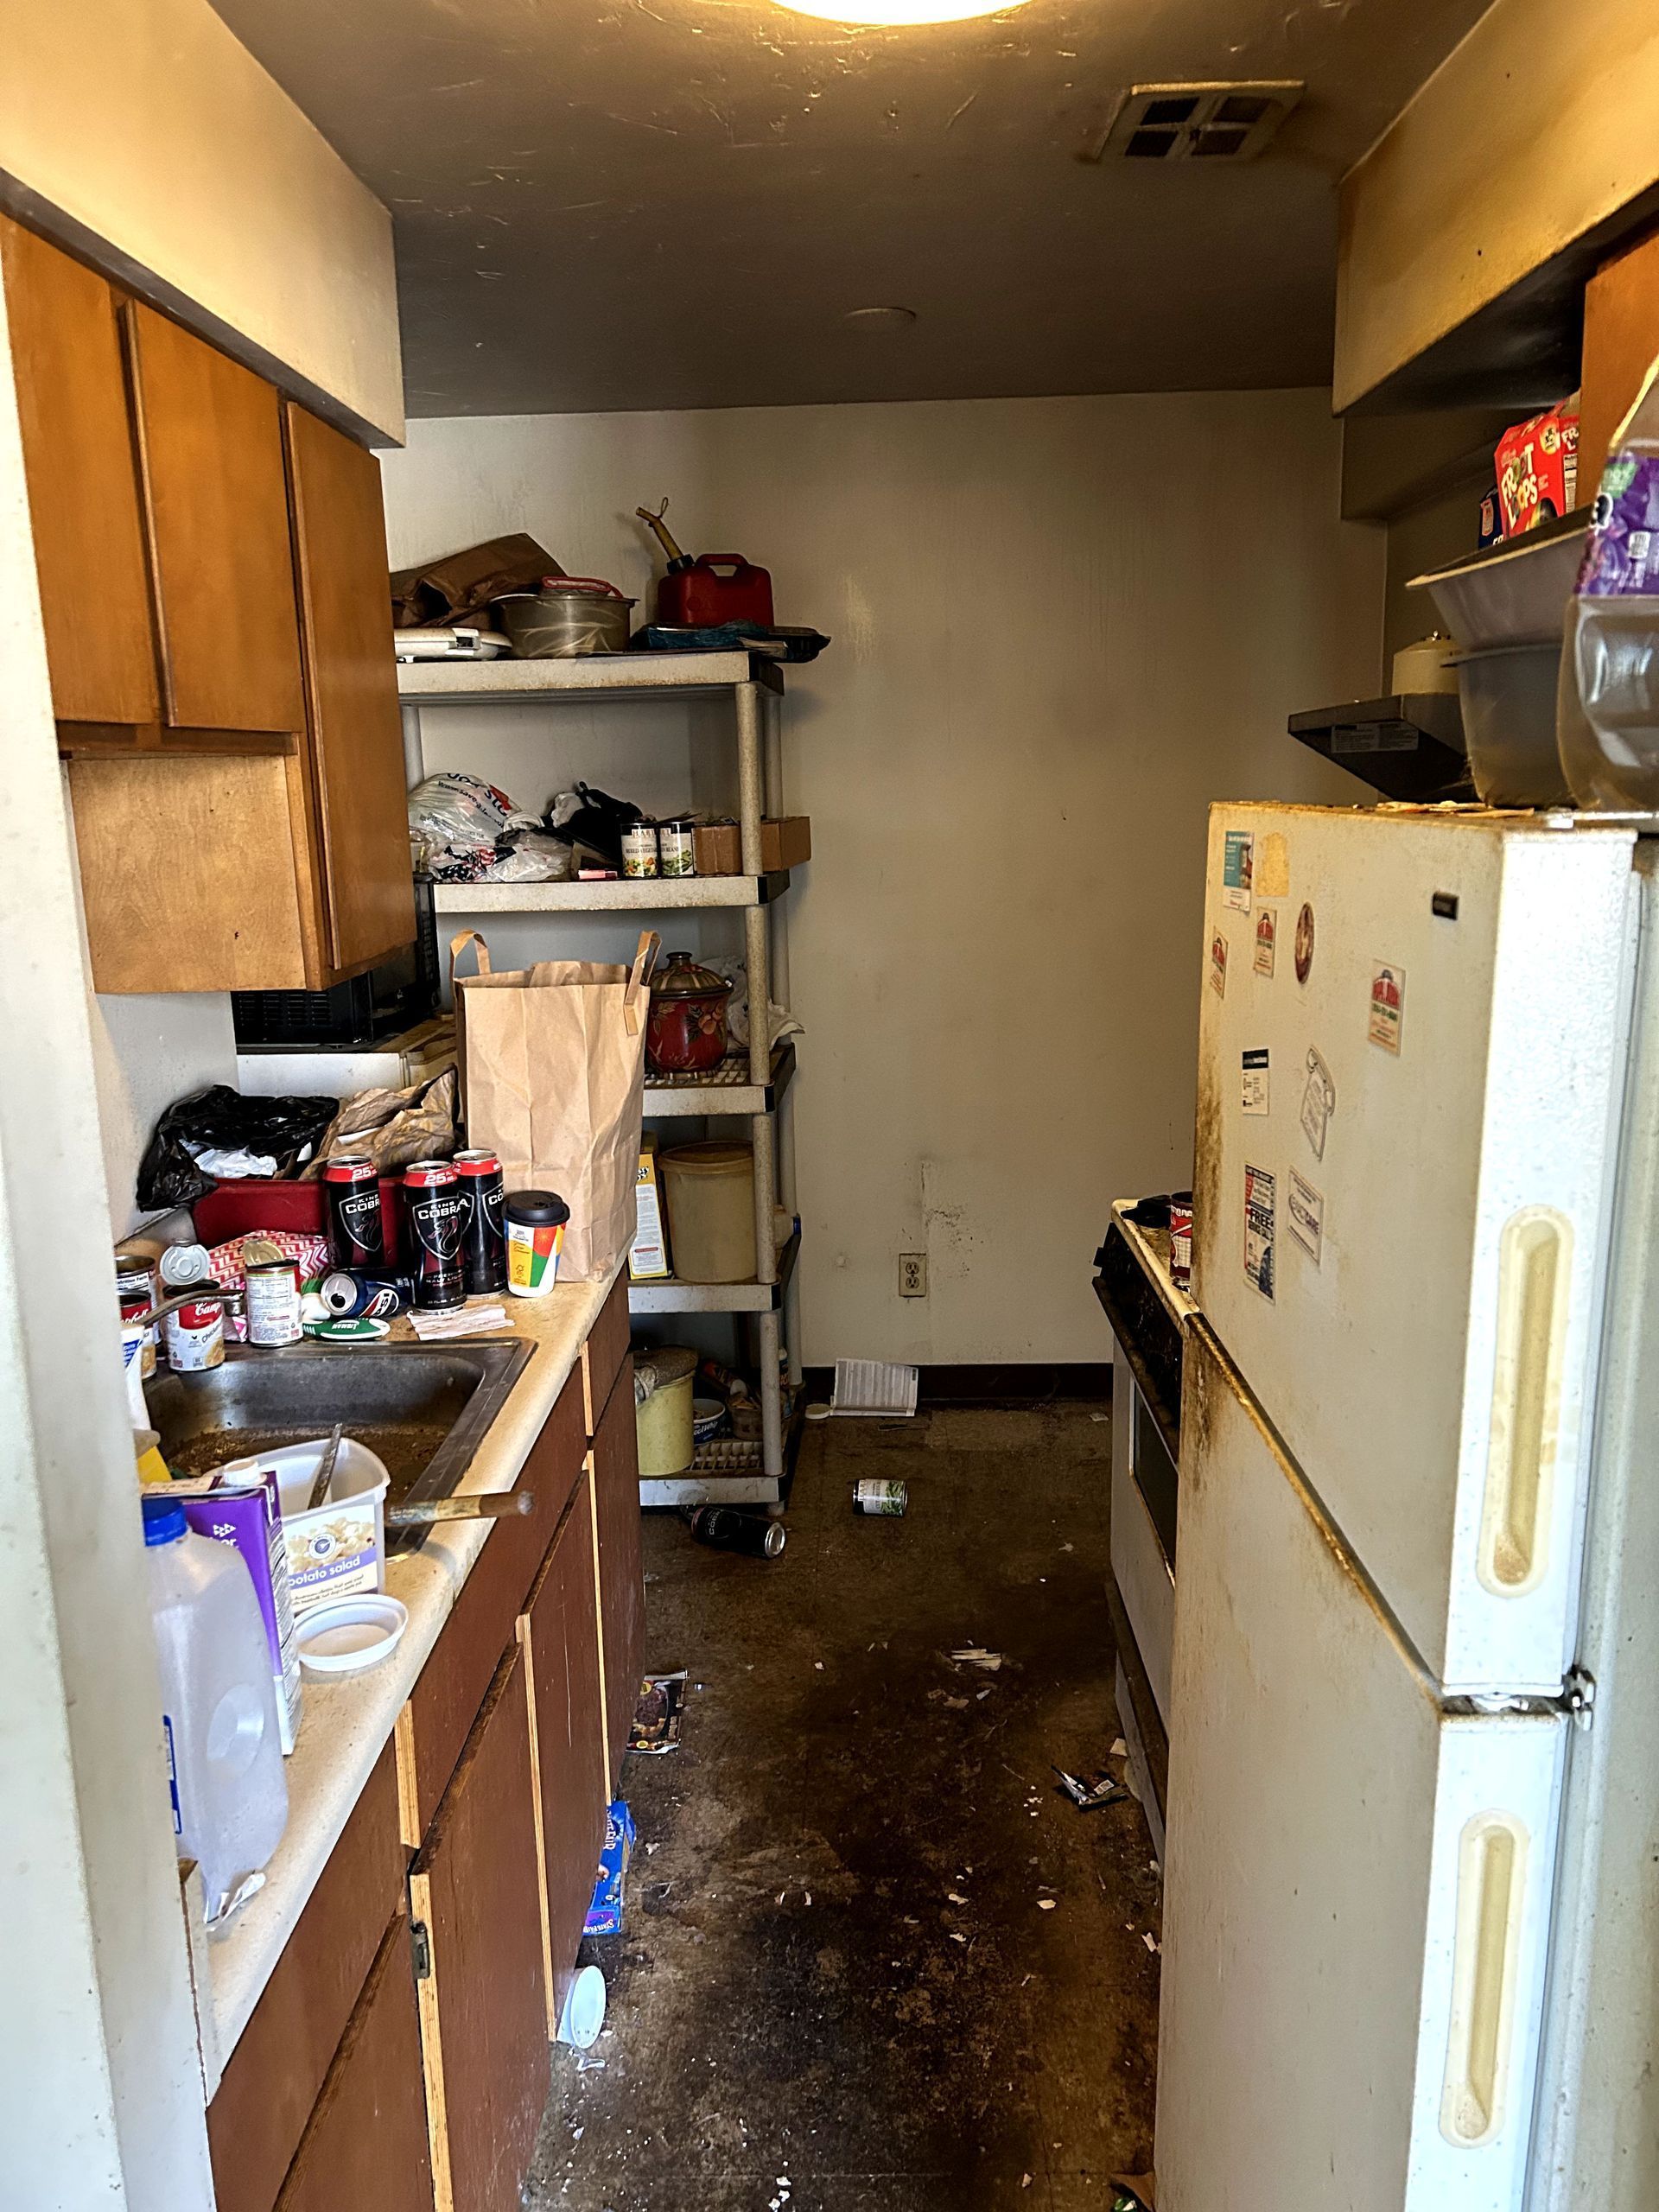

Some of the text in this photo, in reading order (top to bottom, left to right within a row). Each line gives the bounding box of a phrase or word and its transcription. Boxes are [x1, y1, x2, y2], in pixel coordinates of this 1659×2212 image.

[1502, 442, 1534, 508] FROOT
[1507, 474, 1537, 530] LOOPS
[352, 1166, 372, 1179] 25
[423, 1173, 446, 1185] 25
[346, 1198, 380, 1214] COBR
[430, 1201, 454, 1210] KING
[1250, 1208, 1271, 1230] FREE
[329, 1555, 361, 1576] salad
